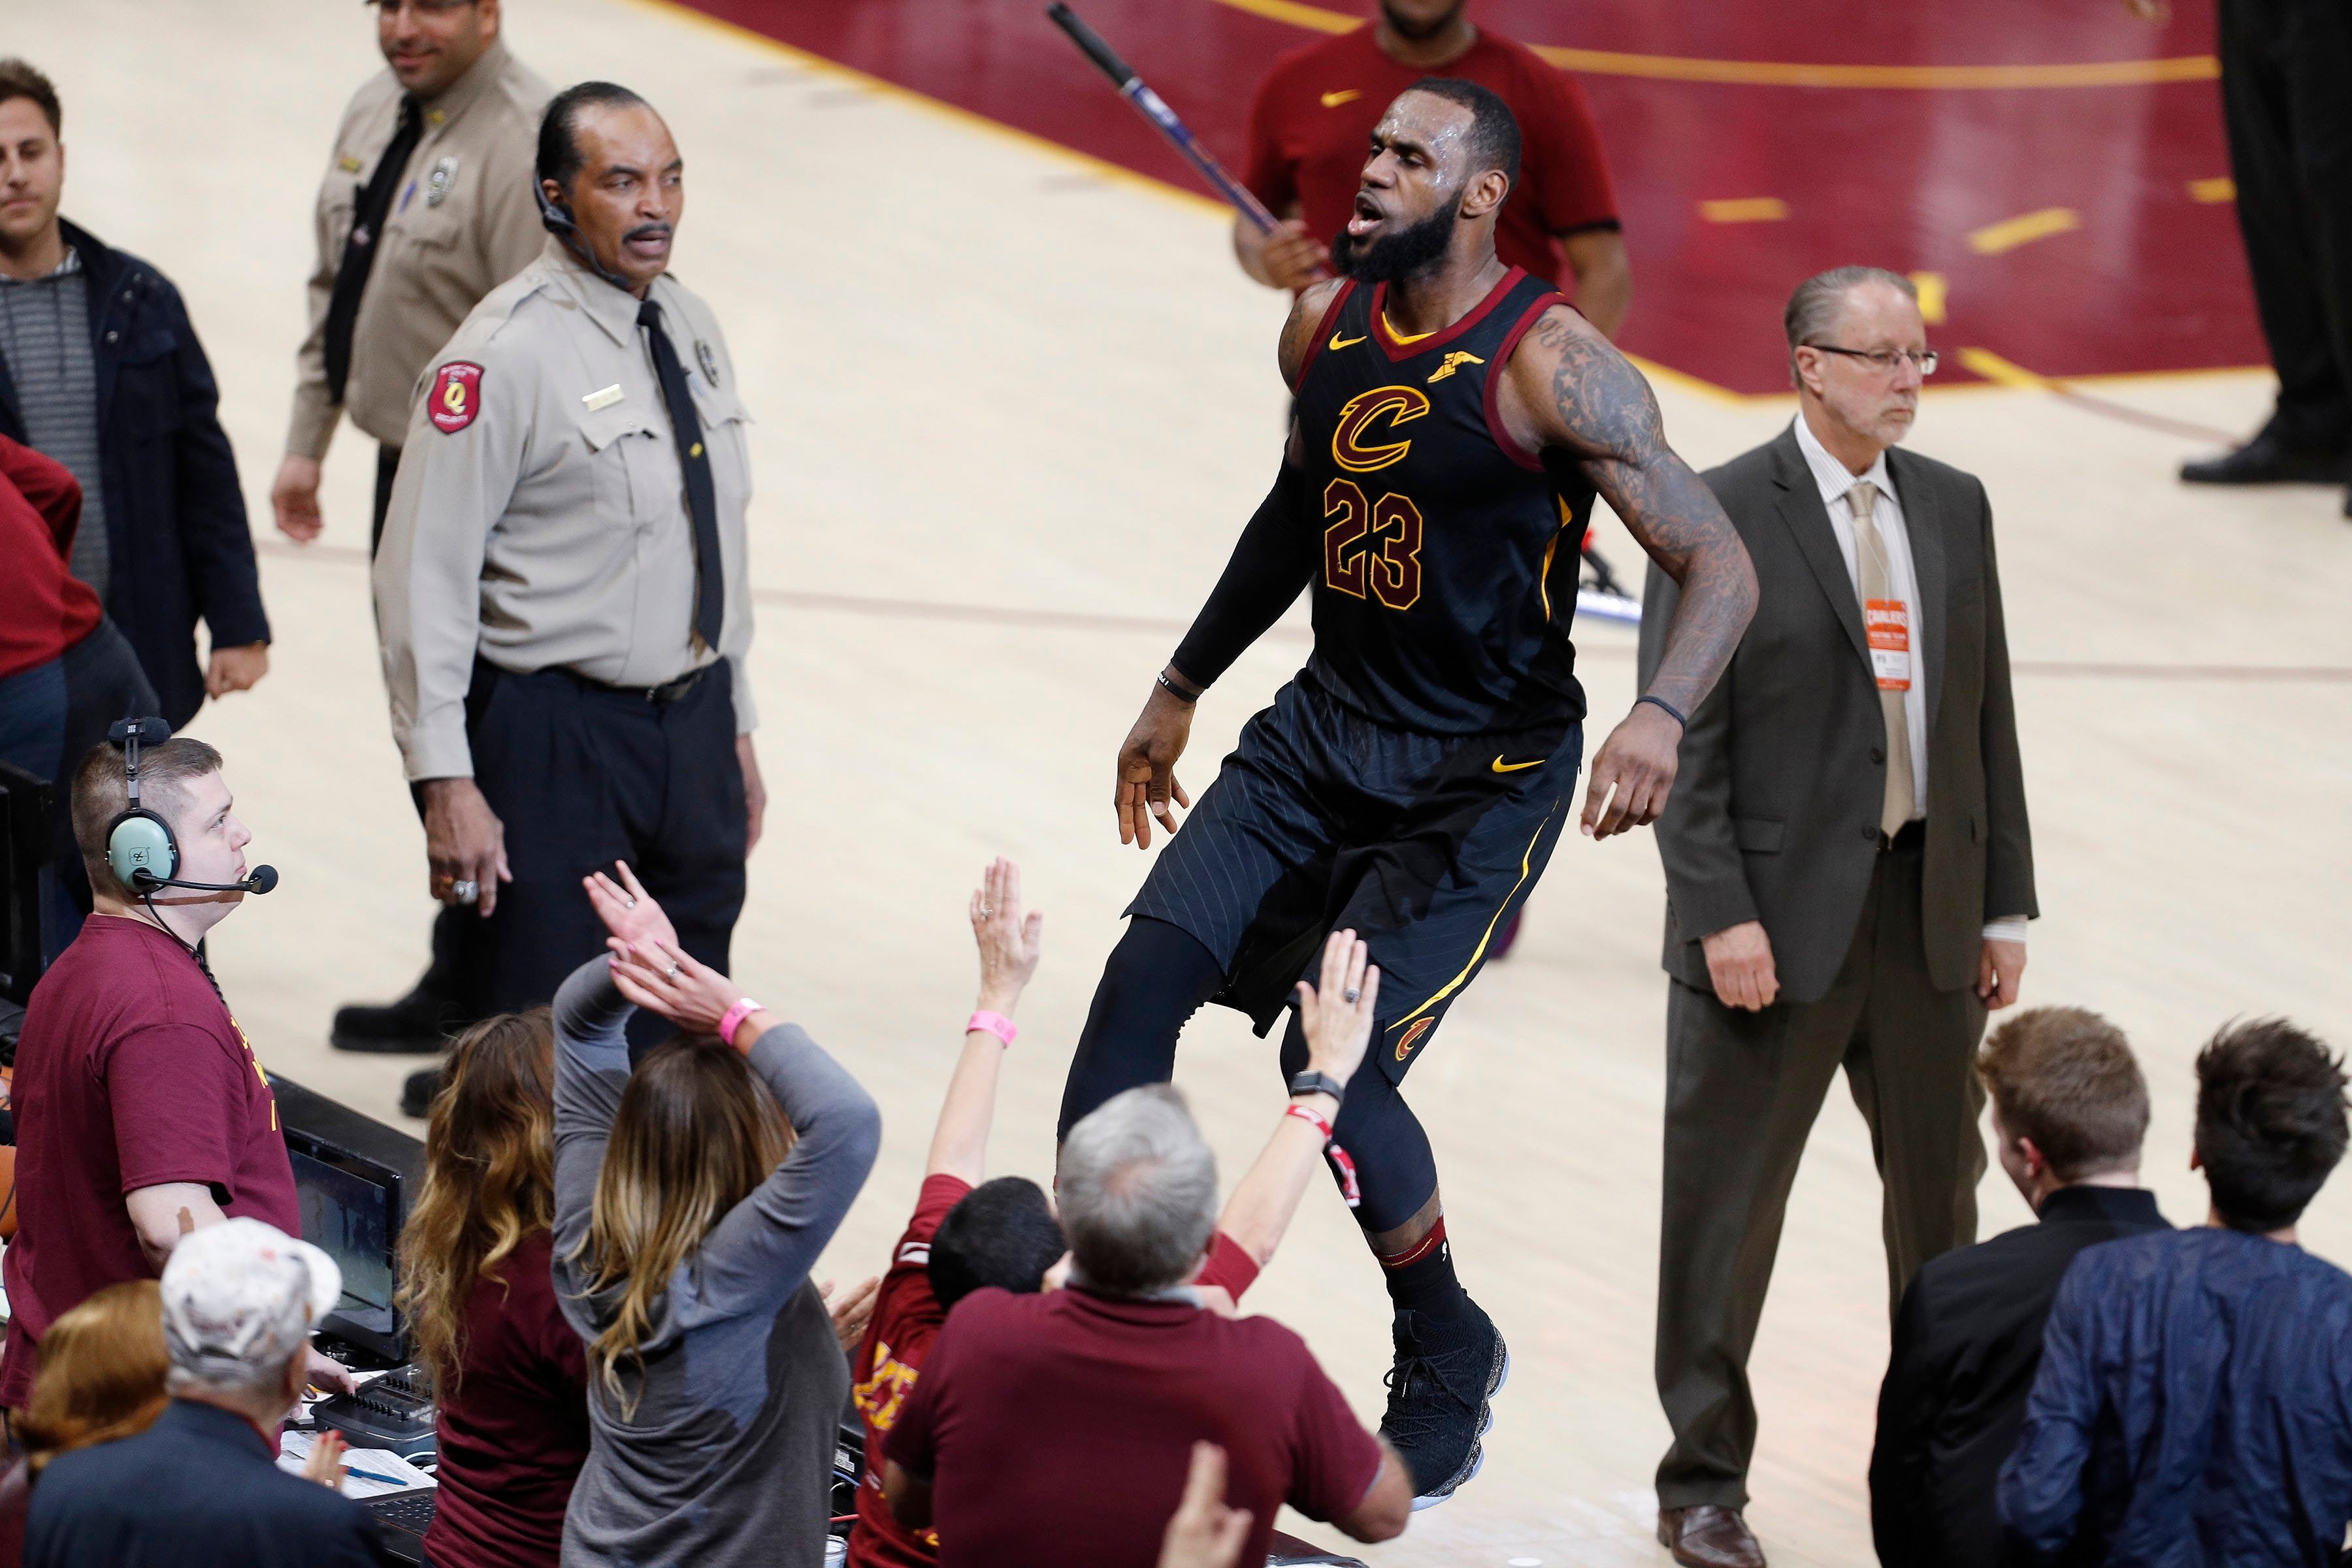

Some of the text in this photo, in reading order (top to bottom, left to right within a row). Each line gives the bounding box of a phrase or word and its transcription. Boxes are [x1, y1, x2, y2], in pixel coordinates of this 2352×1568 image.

[443, 382, 466, 416] Q
[1331, 385, 1431, 472] C
[1324, 477, 1423, 611] 23
